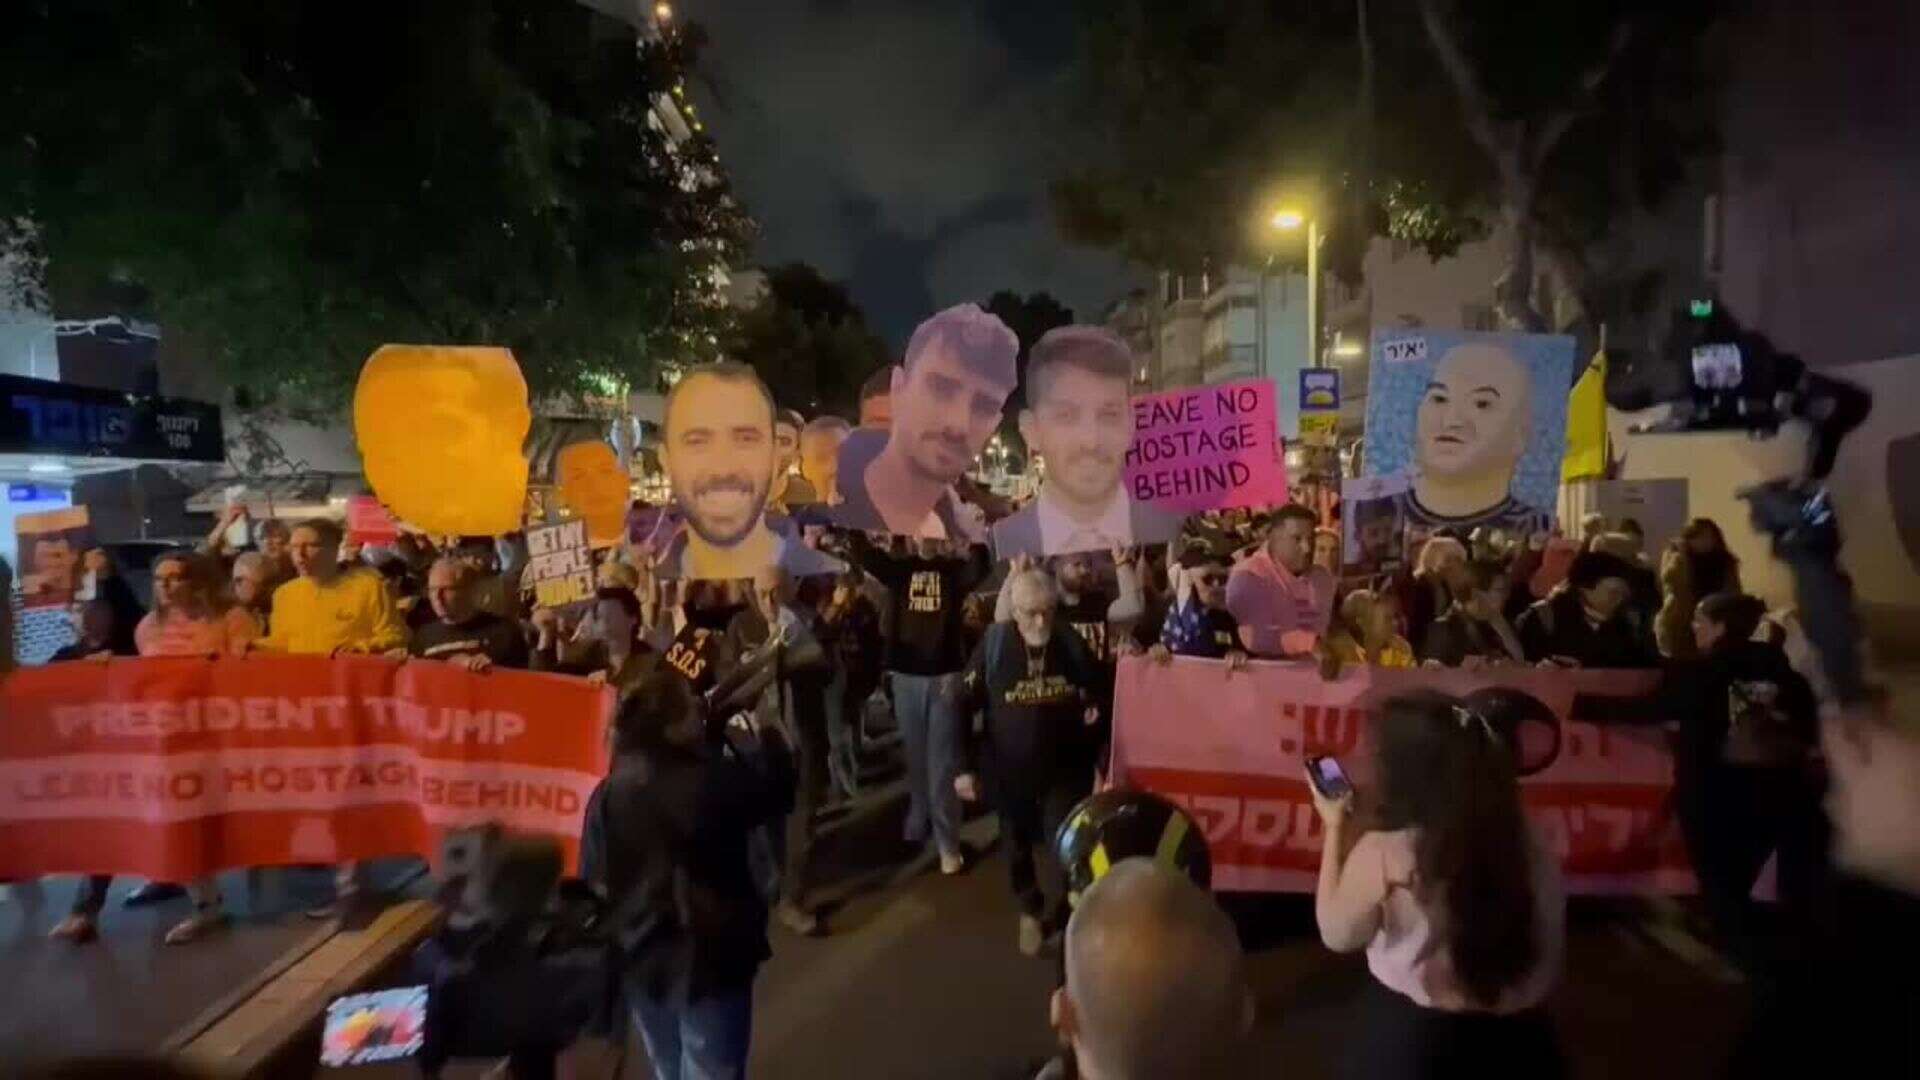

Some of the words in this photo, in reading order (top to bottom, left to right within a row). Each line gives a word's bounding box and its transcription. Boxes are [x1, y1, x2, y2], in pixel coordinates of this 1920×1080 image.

[1387, 341, 1424, 358] יאיר
[1133, 395, 1203, 431] EAVE
[1216, 388, 1258, 416] NO
[1125, 423, 1257, 467] HOSTAGE
[1134, 461, 1250, 500] BEHIND
[52, 696, 347, 737] PRESIDENT
[421, 775, 580, 815] BEHIND
